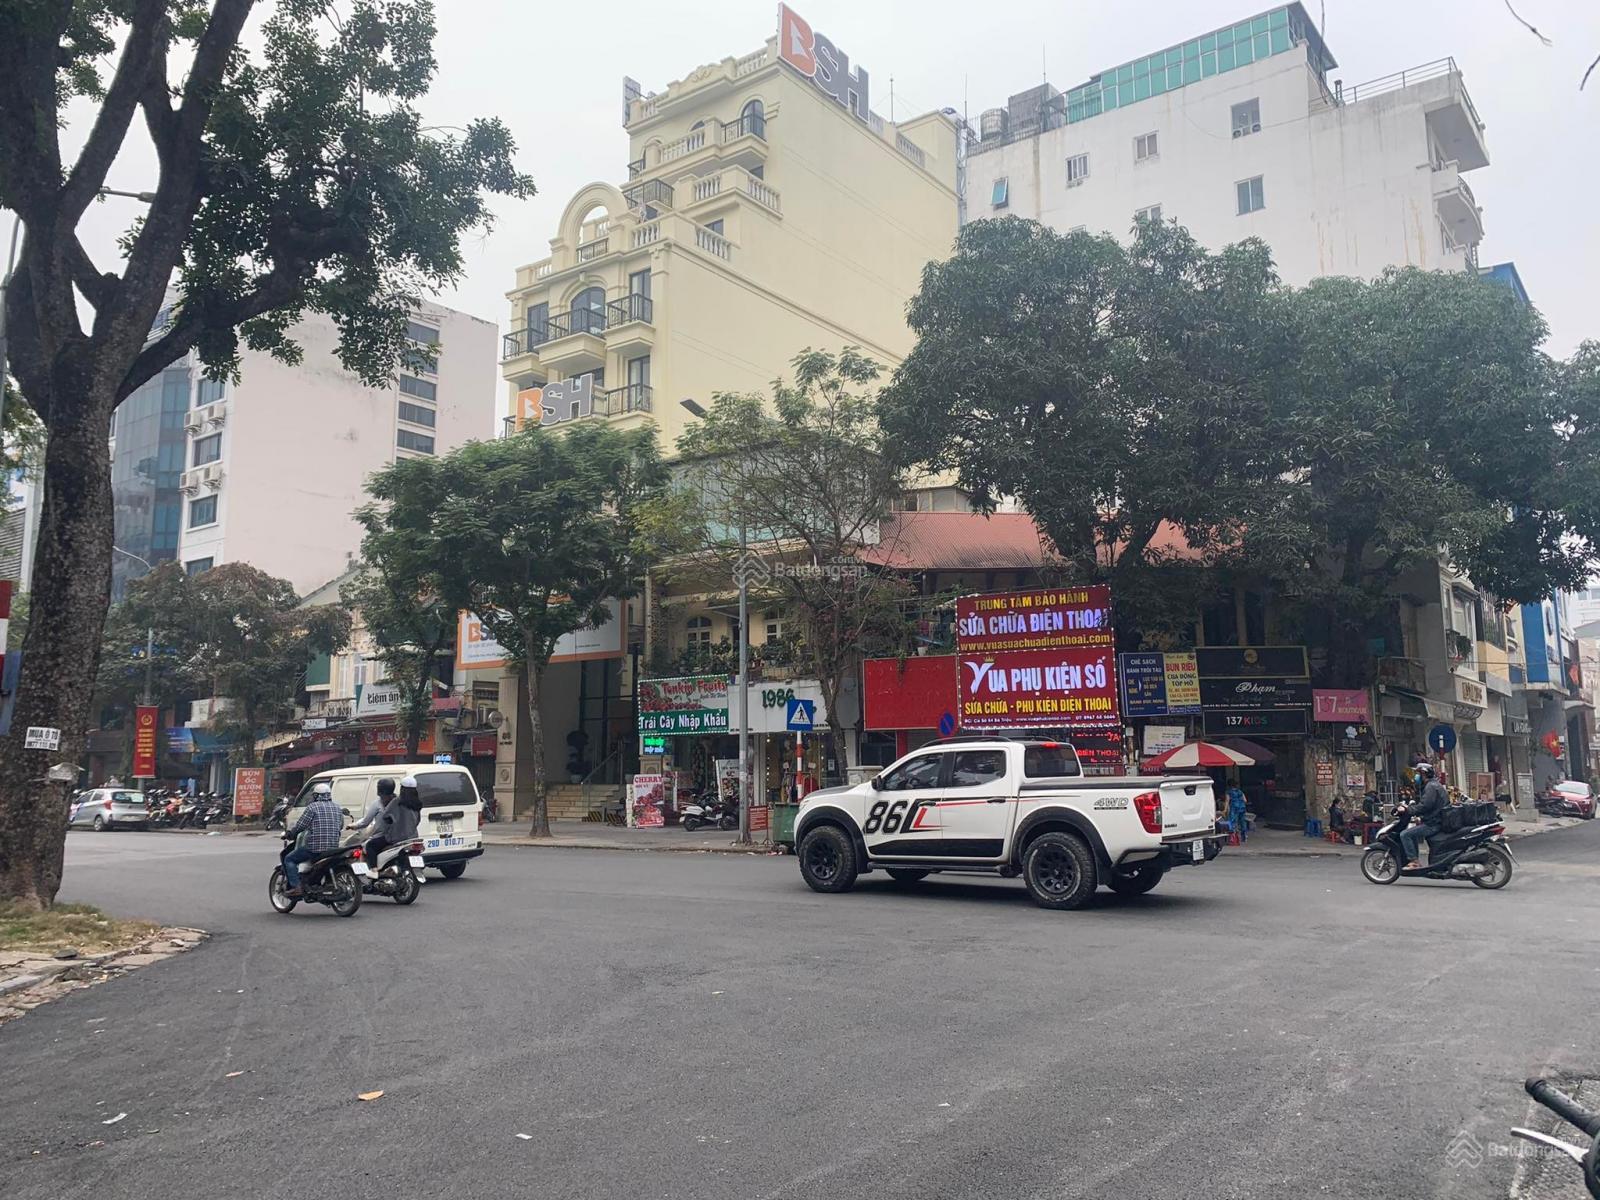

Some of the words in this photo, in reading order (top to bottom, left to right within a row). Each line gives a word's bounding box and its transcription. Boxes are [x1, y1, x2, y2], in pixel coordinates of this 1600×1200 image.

[778, 1, 869, 124] BSH
[515, 373, 592, 433] BSH
[975, 599, 1007, 610] TRUNG
[1010, 594, 1032, 608] TÂM
[1059, 591, 1089, 604] HÀNH
[959, 612, 986, 636] SỬA
[989, 611, 1027, 635] CHỮA
[1030, 608, 1064, 634] ĐIỆN
[960, 634, 1110, 651] www.vuasuachuadienthoai.com
[1011, 667, 1042, 696] PHỤ
[1045, 661, 1082, 695] KIỆN
[1084, 655, 1107, 689] SỐ
[640, 716, 656, 729] Trái
[660, 715, 675, 730] Cây
[679, 714, 700, 730] Nhập
[703, 708, 726, 727] Khẩu
[965, 697, 983, 715] SỬA
[984, 698, 1008, 714] CHỮA
[1016, 700, 1035, 716] PHỤ
[1036, 696, 1058, 715] KIỆN
[1060, 696, 1082, 714] ĐIỆN
[1084, 697, 1112, 713] THOẠI
[863, 801, 908, 834] 86
